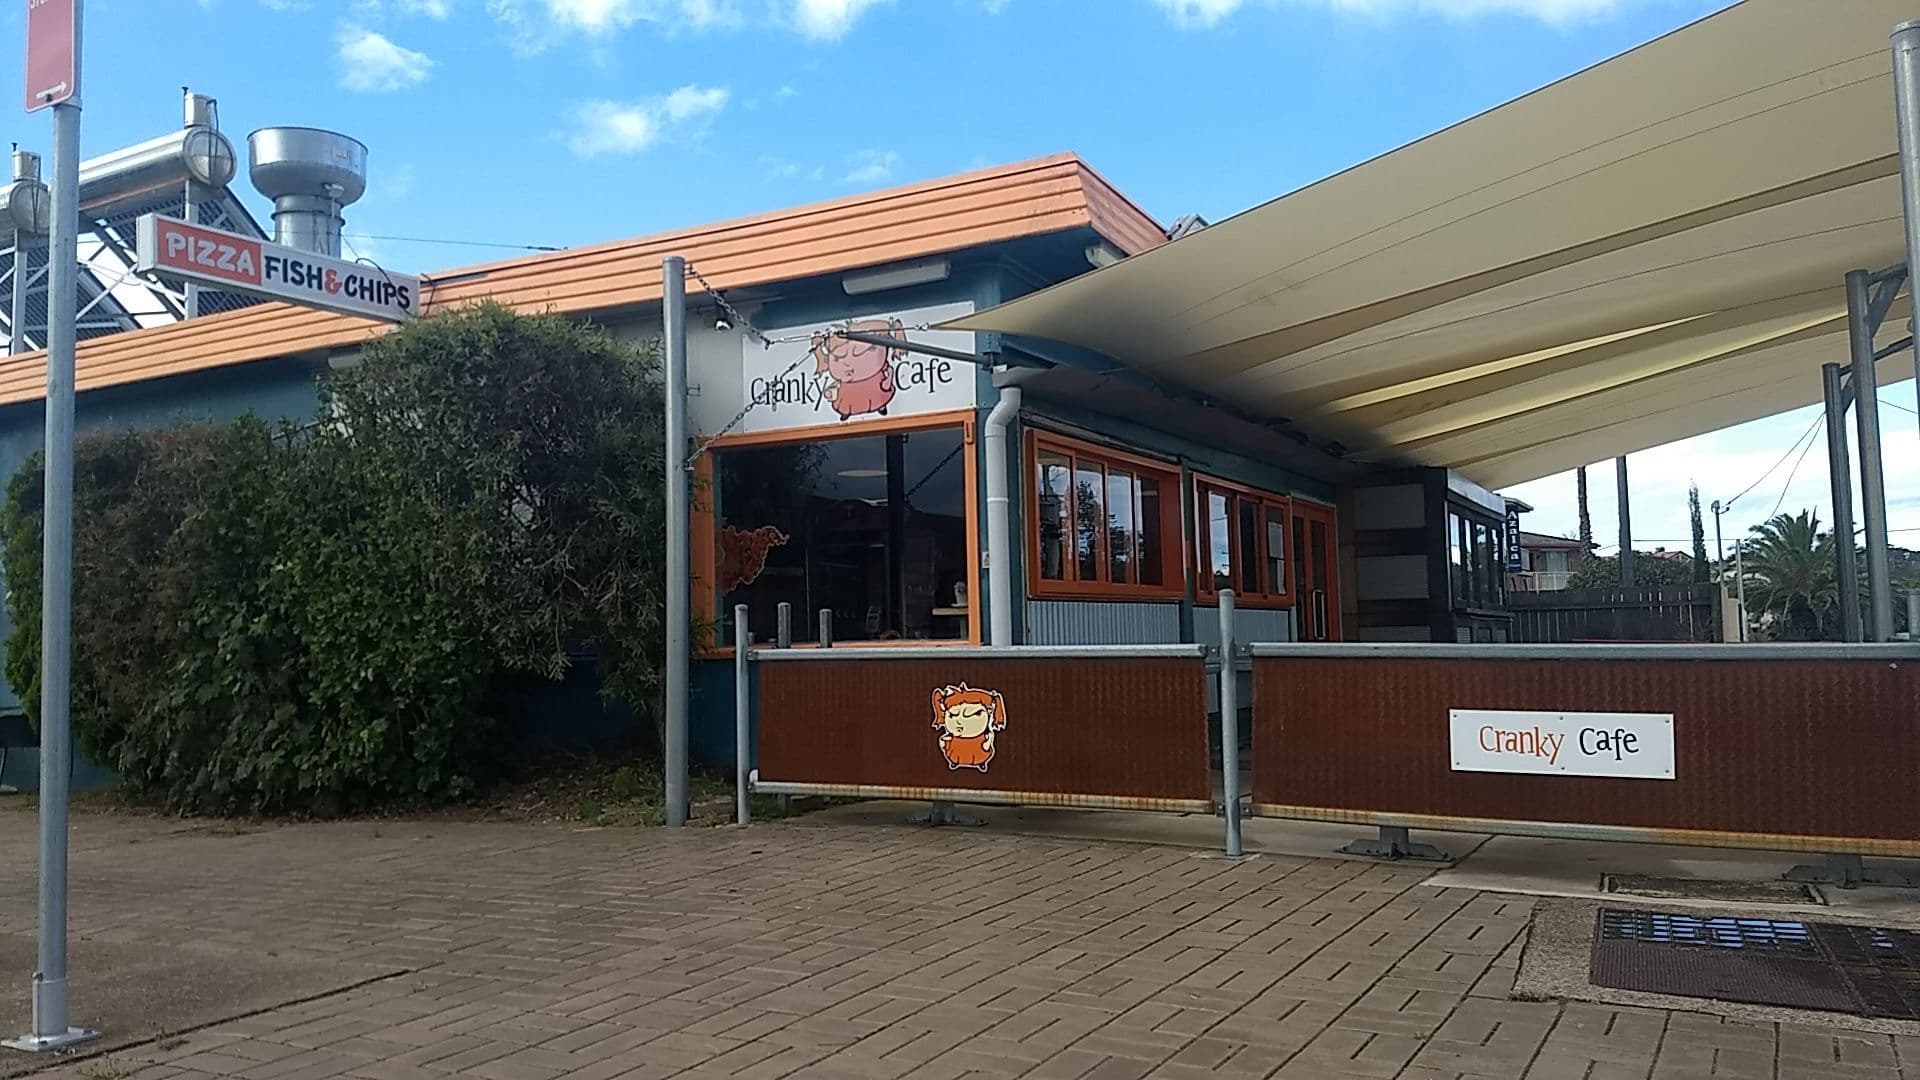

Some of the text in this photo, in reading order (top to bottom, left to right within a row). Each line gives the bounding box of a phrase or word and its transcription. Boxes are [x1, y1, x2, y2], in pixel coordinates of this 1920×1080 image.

[165, 232, 256, 276] PIZZA
[751, 358, 953, 411] Cranky Cafe
[1479, 725, 1639, 765] Cranky Cafe
